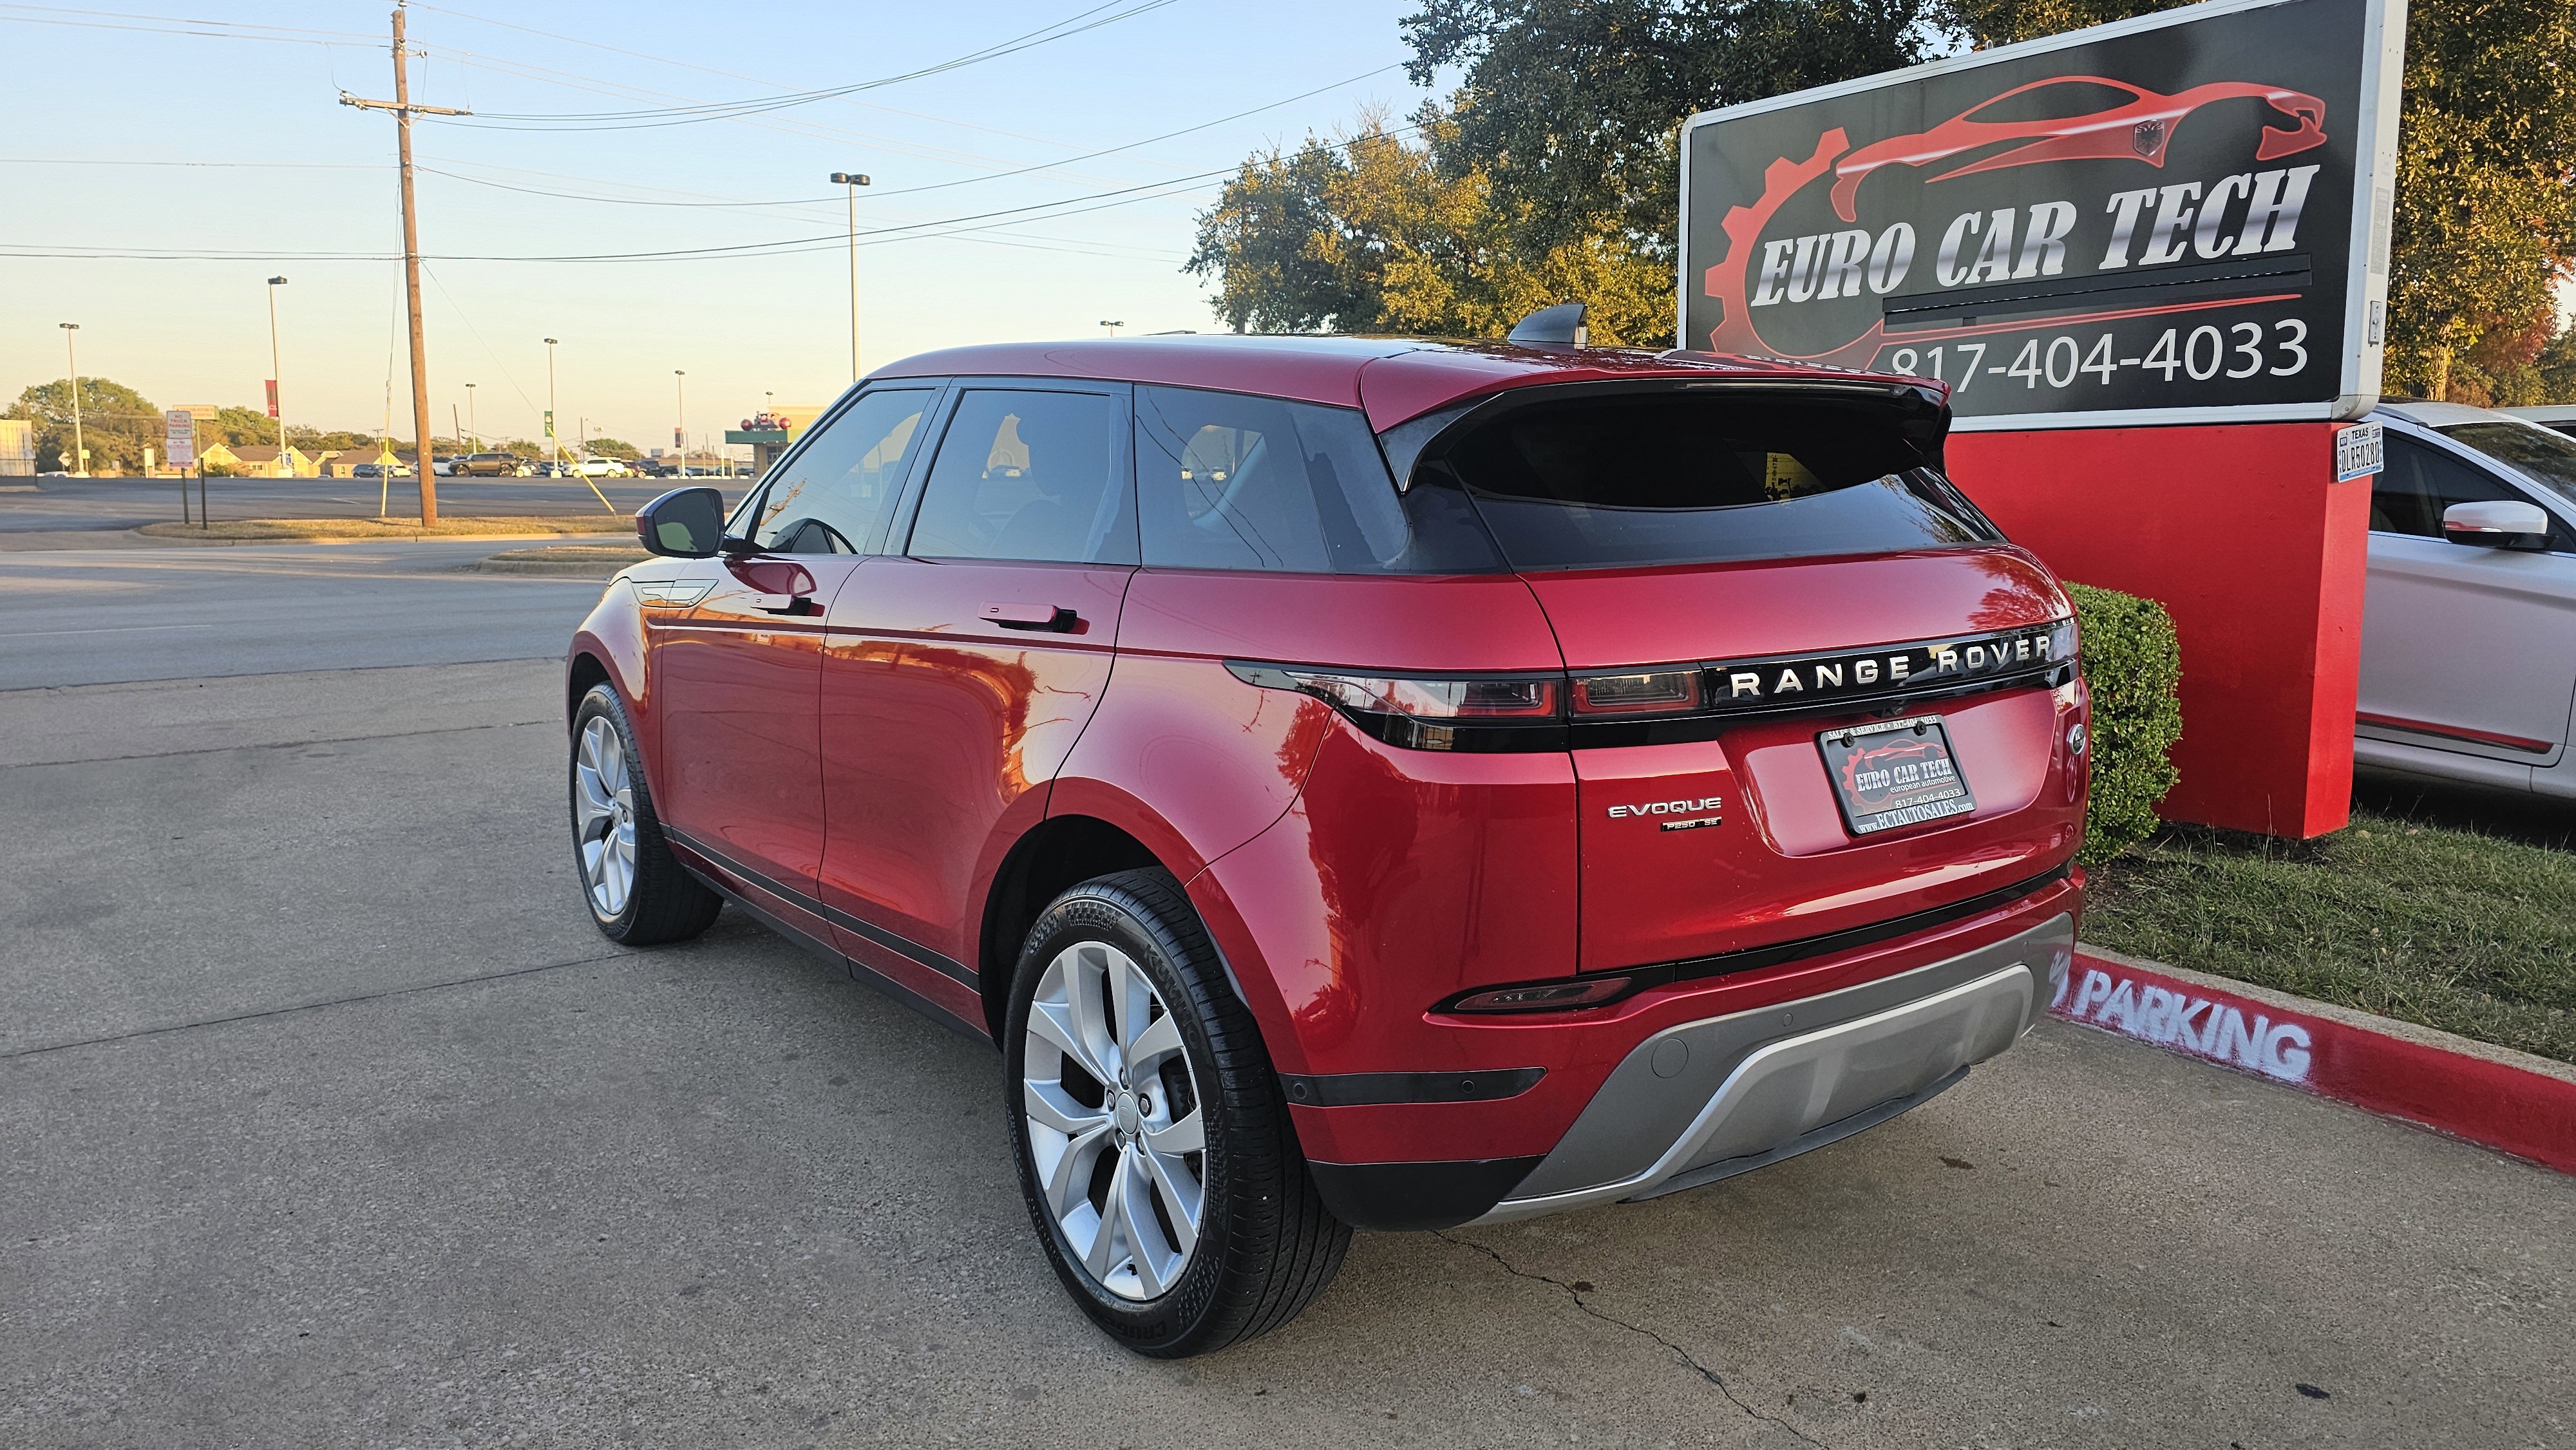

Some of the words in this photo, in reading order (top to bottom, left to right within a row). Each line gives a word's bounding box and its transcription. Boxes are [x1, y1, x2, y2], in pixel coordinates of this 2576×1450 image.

[1750, 222, 1916, 307] EURO
[1936, 201, 2077, 287] CAR
[2098, 164, 2320, 270] TECH
[1891, 318, 2308, 393] 817-404-4033
[2351, 427, 2369, 440] TEXAS
[2342, 441, 2380, 473] DLR50280
[1730, 655, 1909, 698] RANGE
[1936, 636, 2050, 674] ROVER
[1850, 728, 1857, 737] &
[1857, 722, 1886, 735] SERVICE
[1893, 715, 1937, 730] 817-4044033
[1855, 769, 1891, 792] EURO
[1893, 764, 1920, 784] CAR
[1920, 758, 1953, 780] TECH
[1889, 782, 1921, 793] european
[1921, 775, 1956, 788] automotive
[1607, 796, 1722, 818] EVOQUE
[1895, 787, 1961, 809] 817-404-4033
[1666, 822, 1696, 830] P250
[1858, 798, 1975, 833] www.ECTAUTOSALES.com
[1144, 943, 1201, 1050] KUMHO
[2071, 969, 2313, 1084] PARKING
